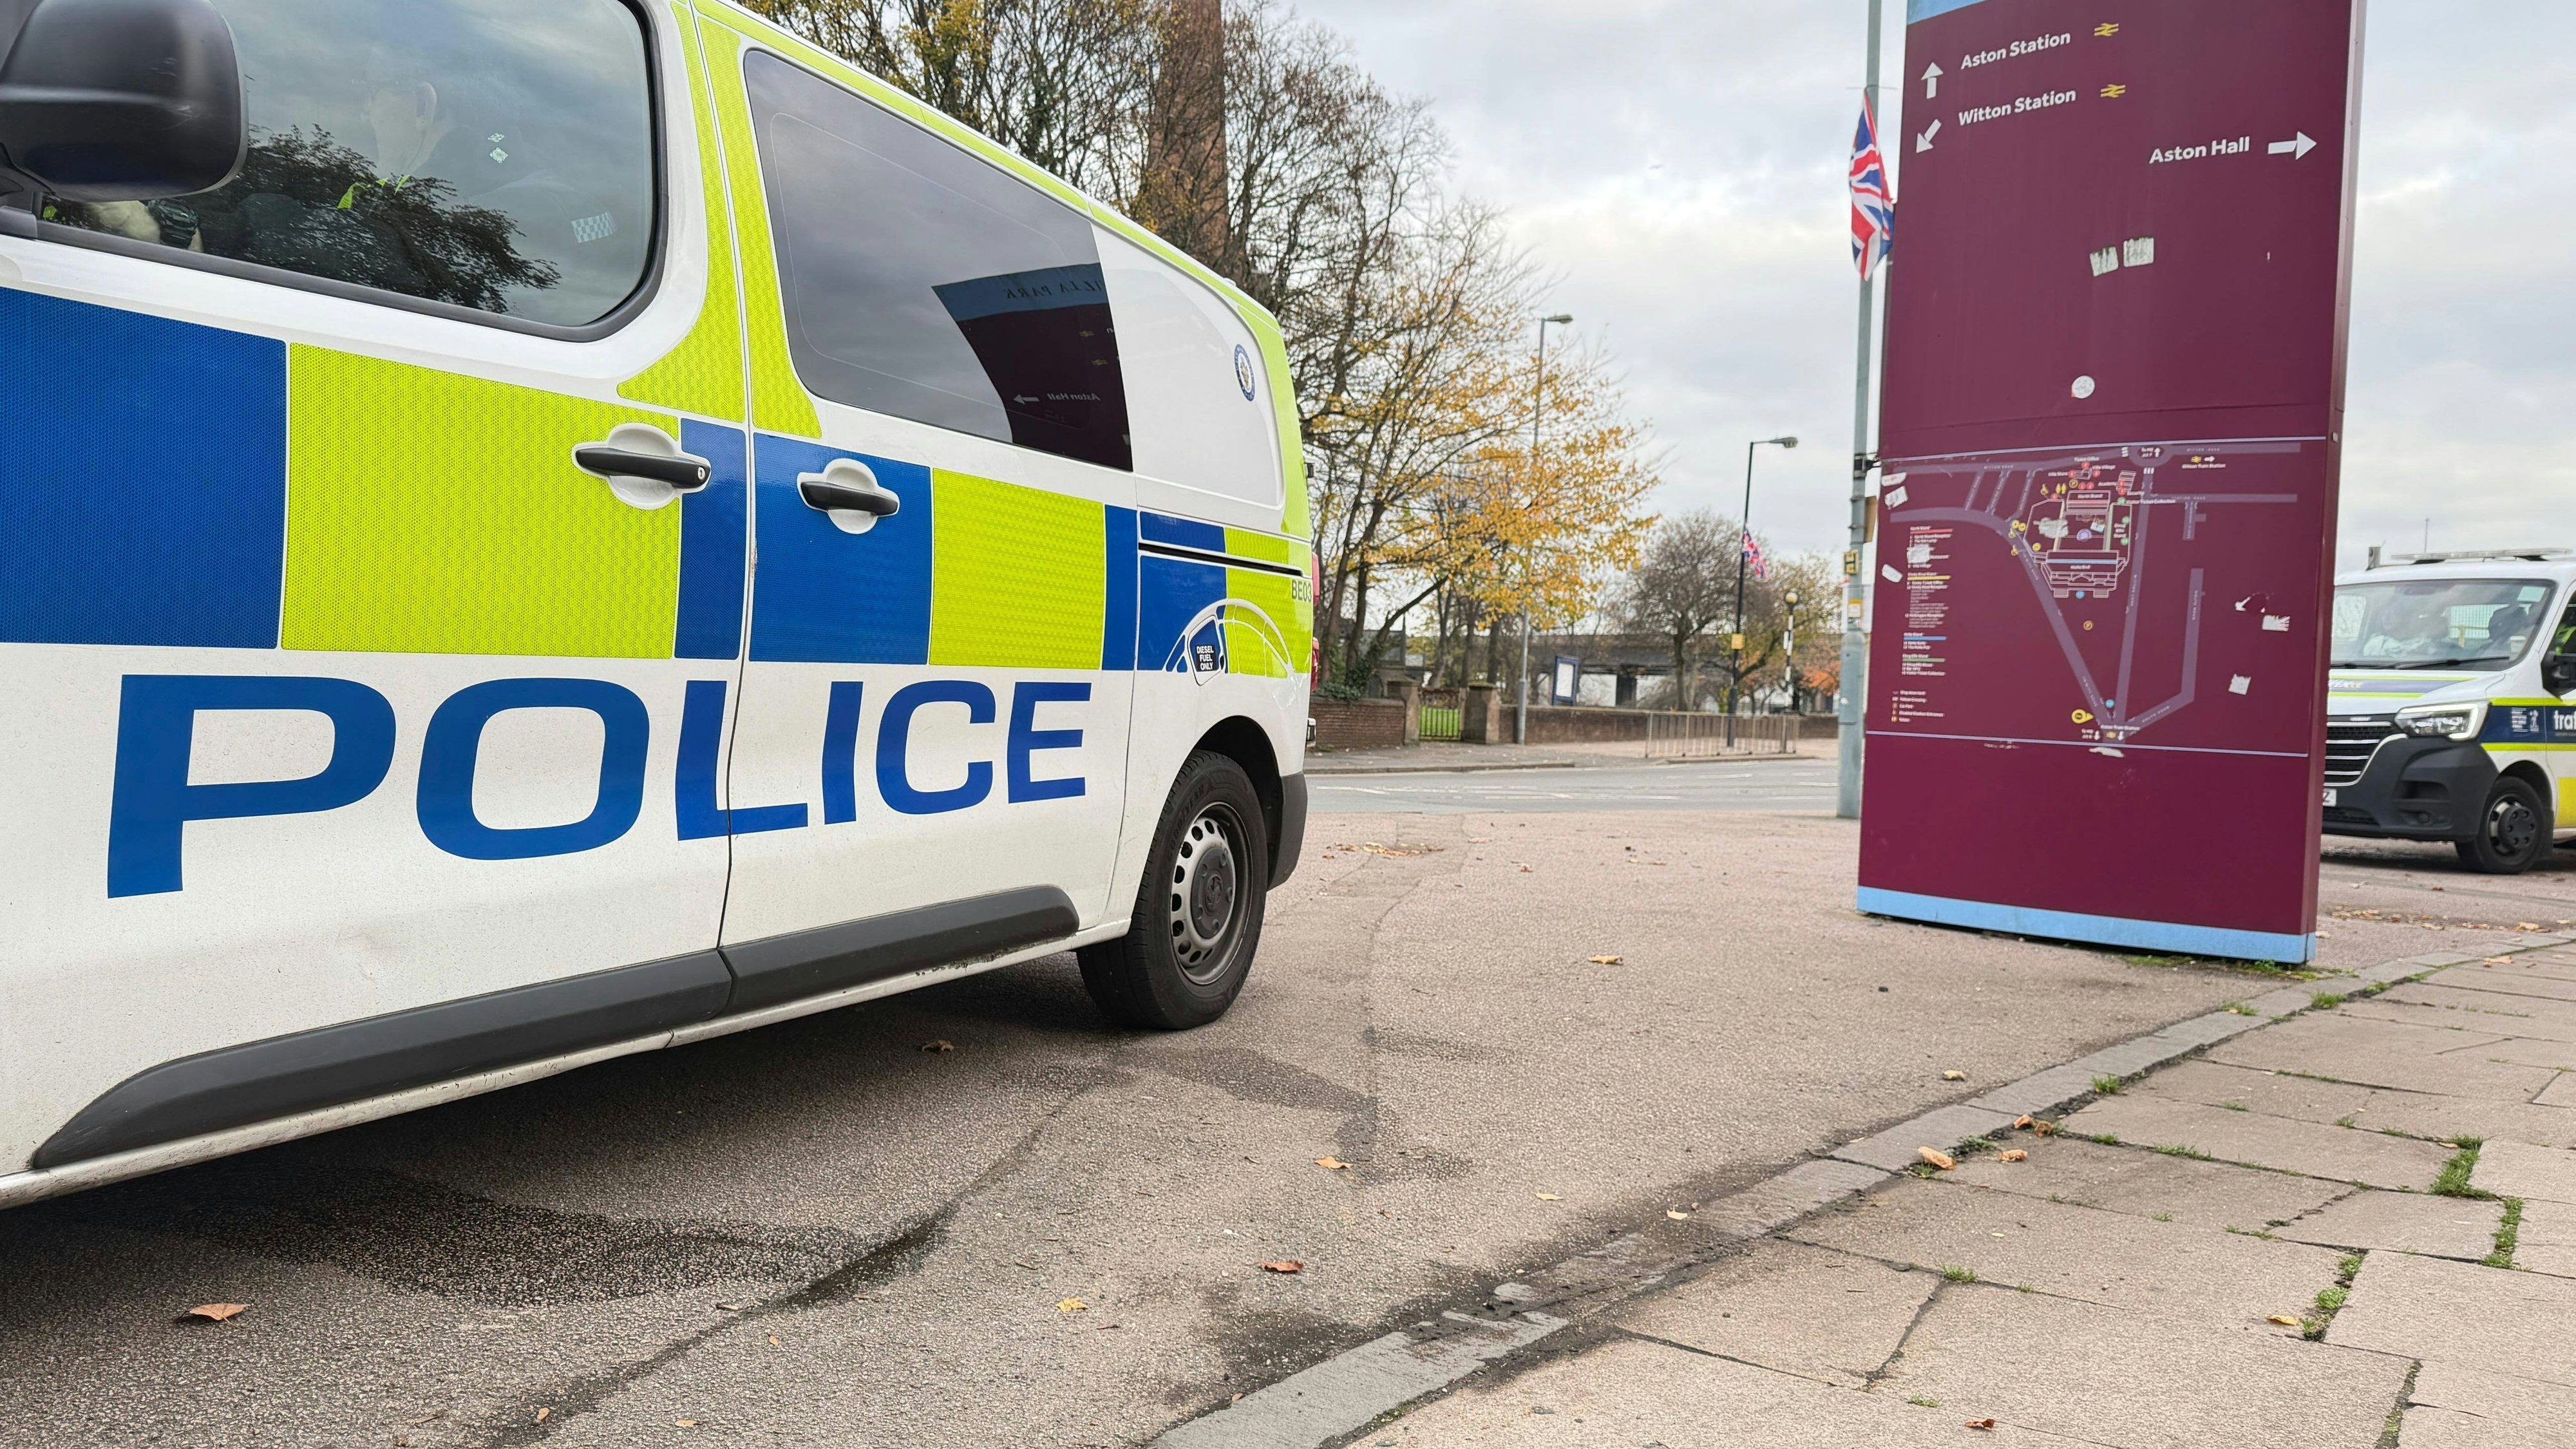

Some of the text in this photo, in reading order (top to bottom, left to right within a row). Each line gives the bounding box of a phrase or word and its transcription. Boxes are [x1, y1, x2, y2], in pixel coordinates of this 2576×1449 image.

[1960, 31, 2071, 70] Aston Station
[1958, 89, 2076, 126] Witton Station
[2149, 136, 2250, 164] Aston Hall
[1292, 579, 1312, 603] BE03
[1197, 645, 1214, 654] DIESEL
[1200, 654, 1213, 662] FUEL
[1200, 662, 1213, 670] ONLY
[107, 674, 1091, 898] POLICE
